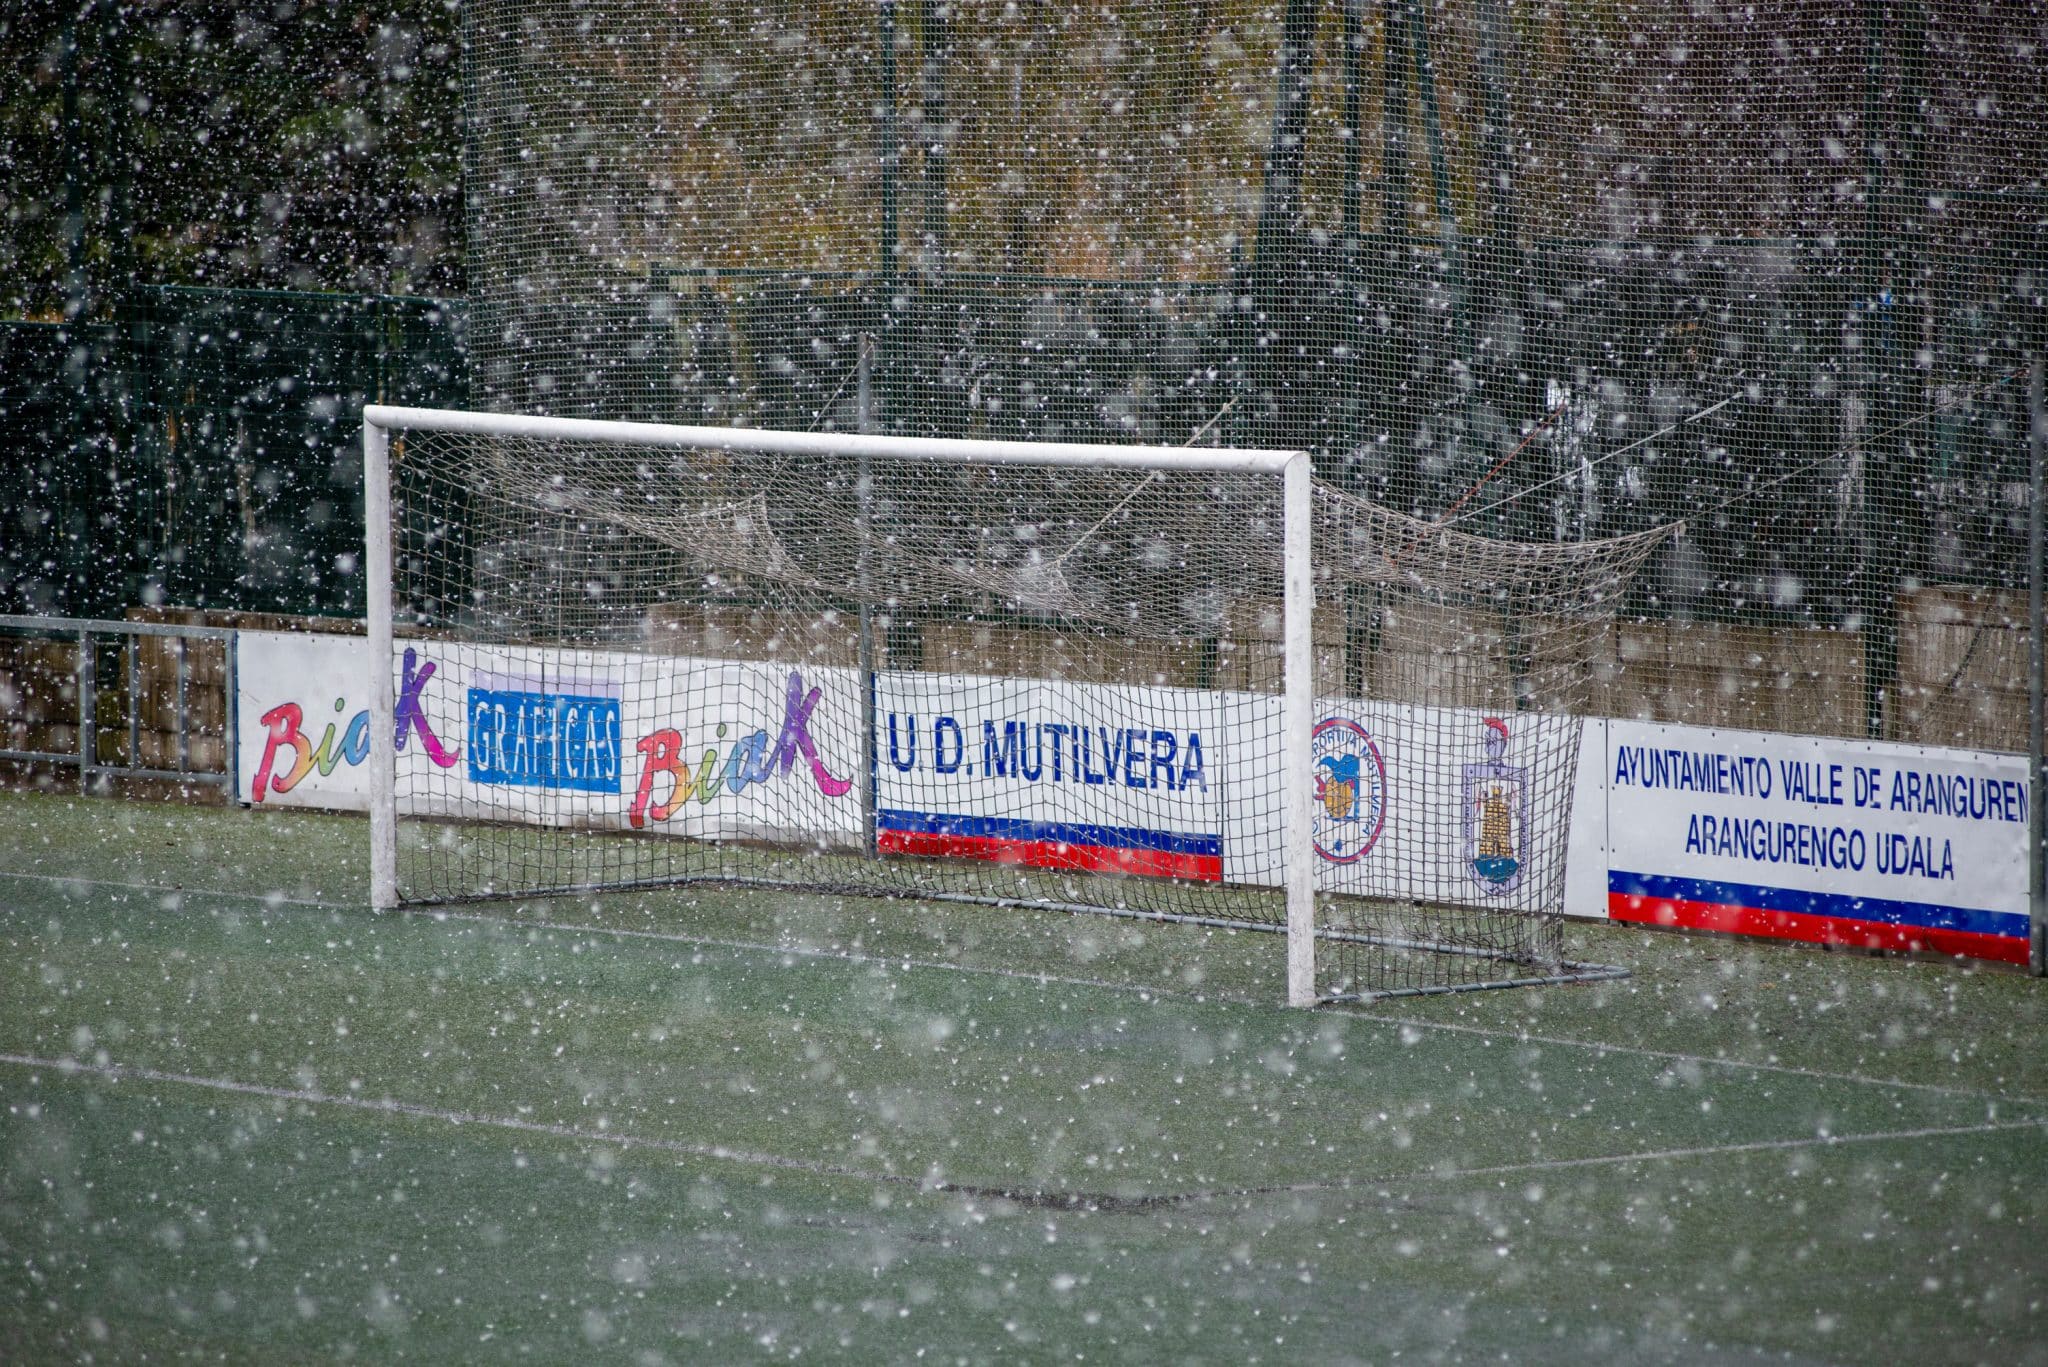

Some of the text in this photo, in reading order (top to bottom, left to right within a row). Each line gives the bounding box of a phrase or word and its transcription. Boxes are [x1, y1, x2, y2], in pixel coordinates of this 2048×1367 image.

[474, 701, 616, 781] GRAFICAS
[984, 719, 1208, 793] MUTILVERA
[1615, 745, 2028, 824] AYUNTAMIENTO VALLE DE ARANGUREN
[1686, 814, 1954, 880] ARANGURENGO UDALA
